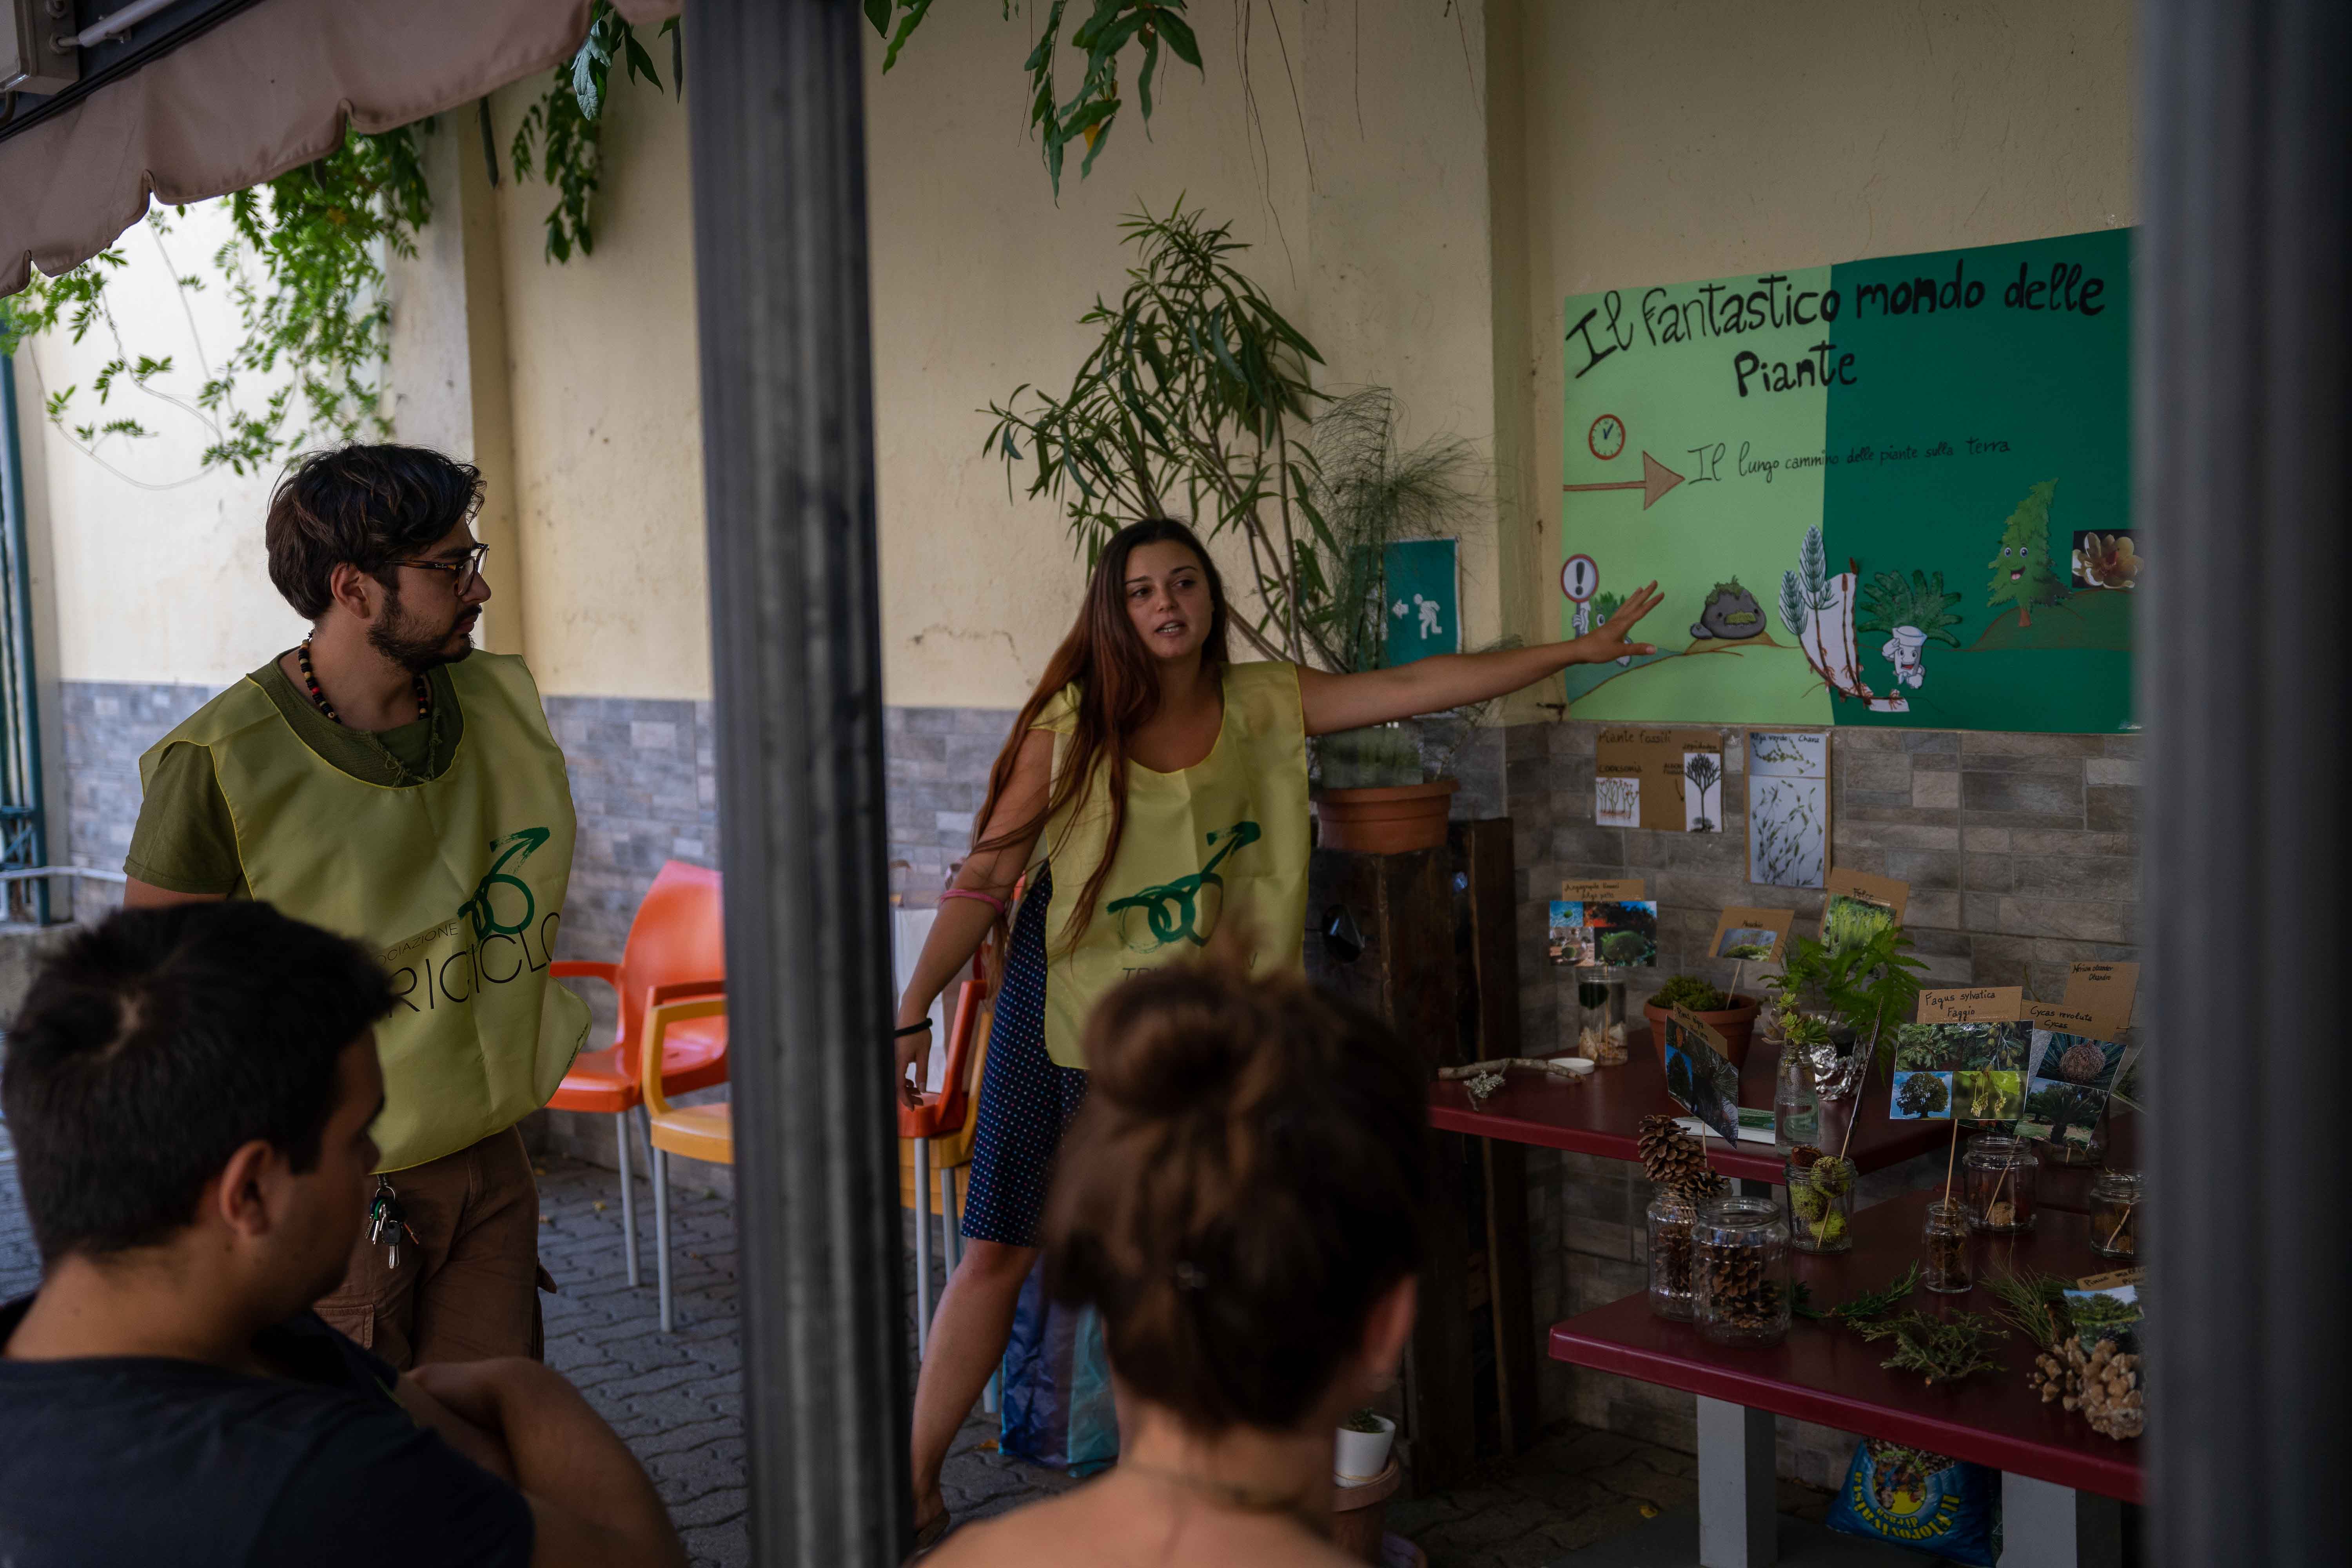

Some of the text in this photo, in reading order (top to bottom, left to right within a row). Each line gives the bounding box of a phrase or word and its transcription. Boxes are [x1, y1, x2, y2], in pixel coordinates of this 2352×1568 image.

[1566, 258, 2105, 378] Il fantastico mondo delle
[1735, 340, 1857, 396] Piante
[1687, 443, 1726, 485] Il
[1739, 441, 1780, 483] lungo
[1785, 449, 1839, 469] cammino
[1846, 446, 1875, 464] delle
[1879, 445, 1918, 466] piante
[1924, 439, 1954, 458] sulla
[375, 922, 459, 967] OCIAZIONE
[388, 912, 561, 1018] RICICLO
[1925, 989, 1996, 1010] Fagus sylvatica
[1947, 1006, 1975, 1022] Faggio
[2030, 1006, 2092, 1022] Cycas revoluta
[2044, 1019, 2069, 1029] Cycas
